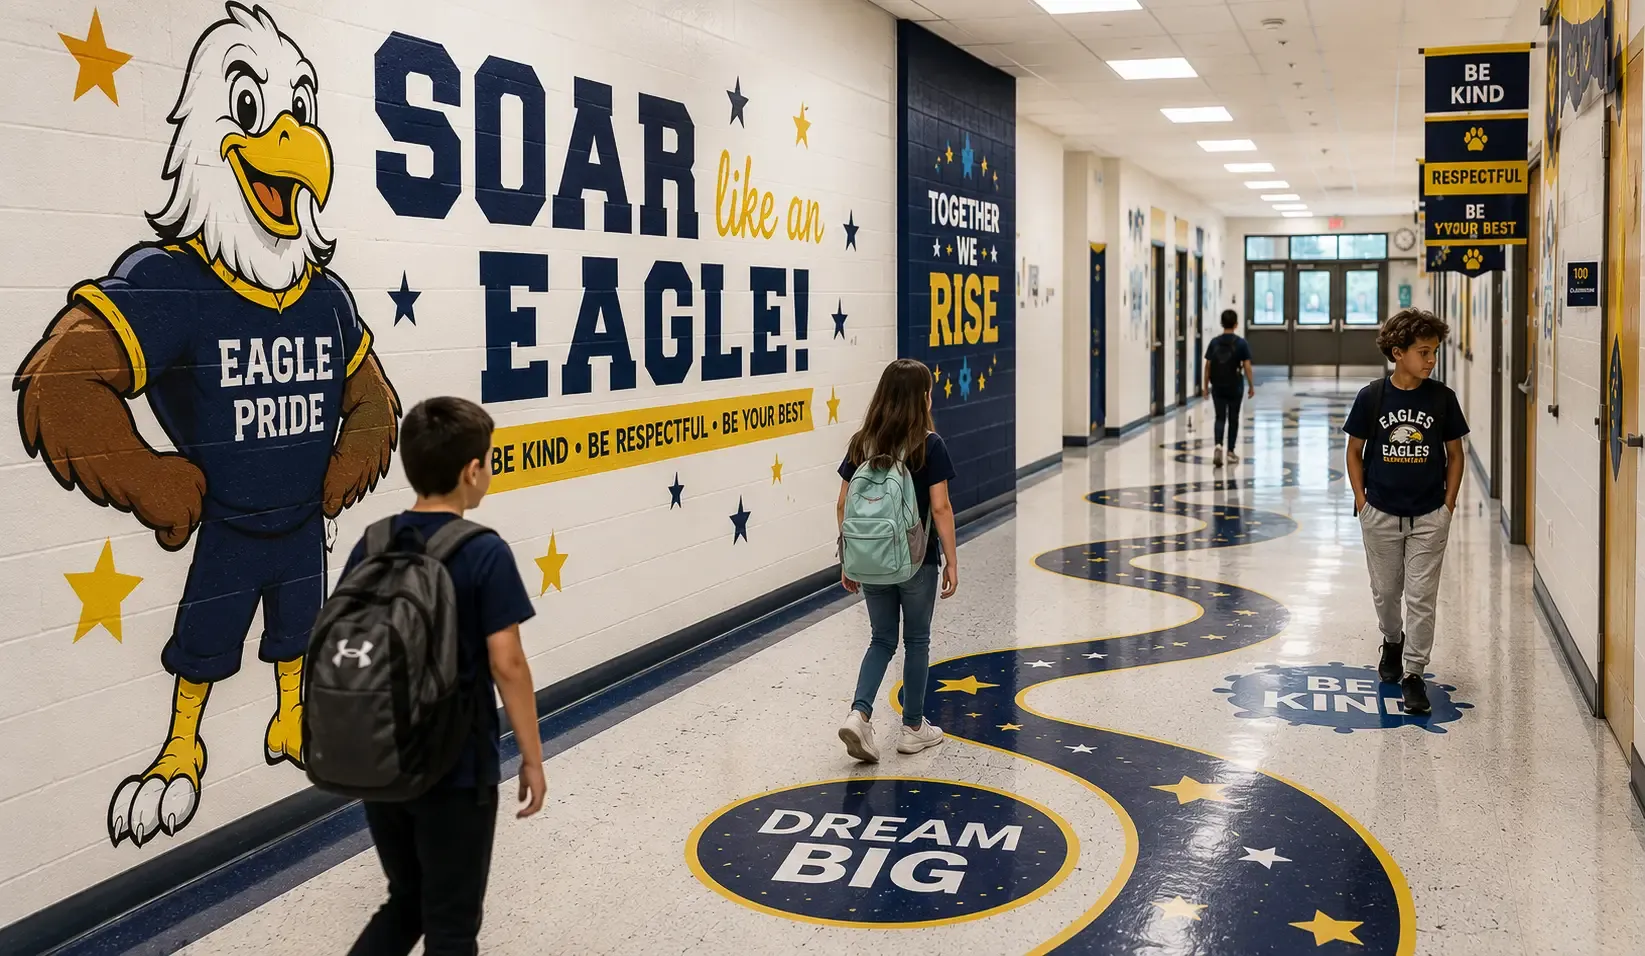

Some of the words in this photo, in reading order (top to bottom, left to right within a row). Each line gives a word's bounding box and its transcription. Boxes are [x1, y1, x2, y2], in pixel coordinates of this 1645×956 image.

[1464, 63, 1491, 82] BE
[1451, 85, 1504, 104] KIND
[374, 30, 698, 240] SOAR
[1432, 167, 1522, 184] RESPECTFUL
[716, 149, 778, 240] like
[787, 195, 825, 244] an
[928, 189, 1000, 233] TOGETHER
[1465, 204, 1485, 219] BE
[1483, 221, 1517, 235] BEST
[956, 235, 978, 266] WE
[1572, 267, 1589, 280] 100
[479, 250, 809, 404] EAGLE!
[929, 271, 999, 347] RISE
[218, 335, 334, 388] EAGLE
[234, 392, 324, 441] PRIDE
[1379, 408, 1434, 429] EAGLES
[491, 444, 515, 475] BE
[522, 437, 569, 470] KIND
[588, 430, 610, 459] BE
[616, 415, 708, 454] RESPECTFUL
[722, 411, 739, 435] BE
[742, 406, 775, 430] YOUR
[778, 400, 805, 425] BEST
[1382, 444, 1430, 457] EAGLES
[1307, 675, 1377, 694] BE
[757, 809, 1023, 851] DREAM
[771, 842, 969, 894] BIG
